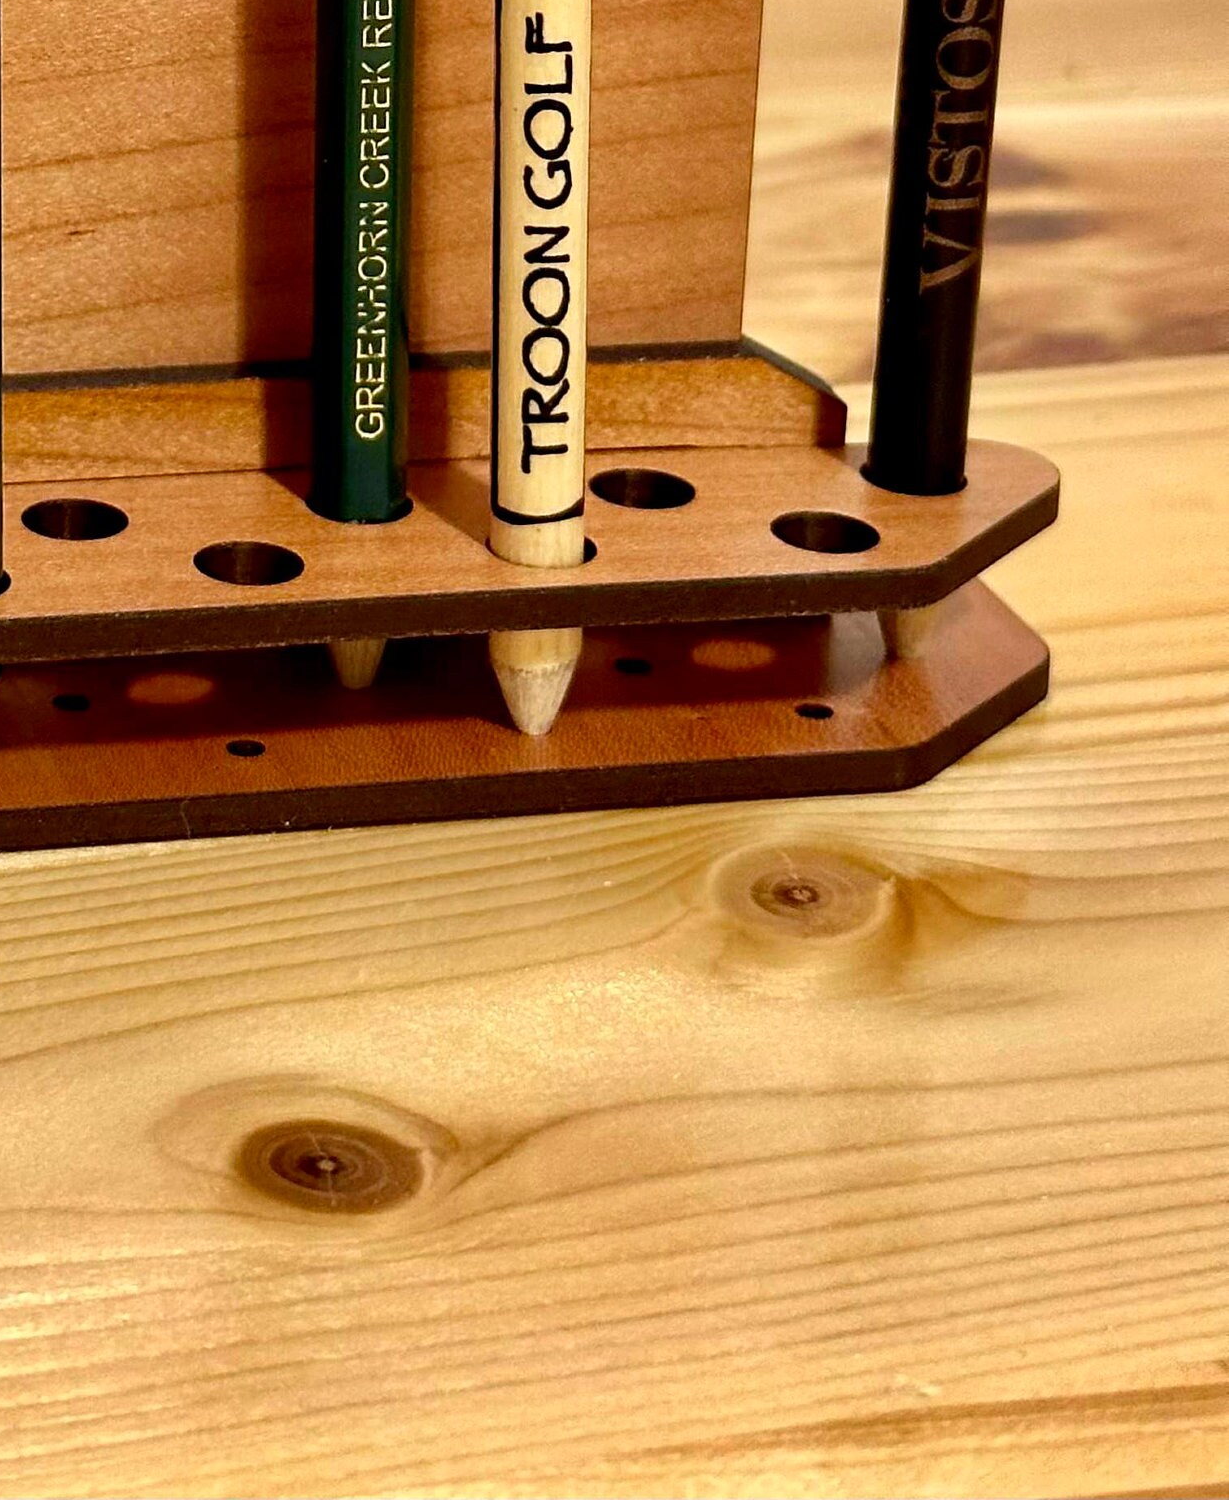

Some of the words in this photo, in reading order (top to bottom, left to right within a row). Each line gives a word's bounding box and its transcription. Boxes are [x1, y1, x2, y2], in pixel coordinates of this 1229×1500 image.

[359, 60, 392, 191] CREEK
[523, 11, 573, 210] GOLF
[355, 201, 390, 441] GREENHORN
[521, 224, 571, 474] TROON
